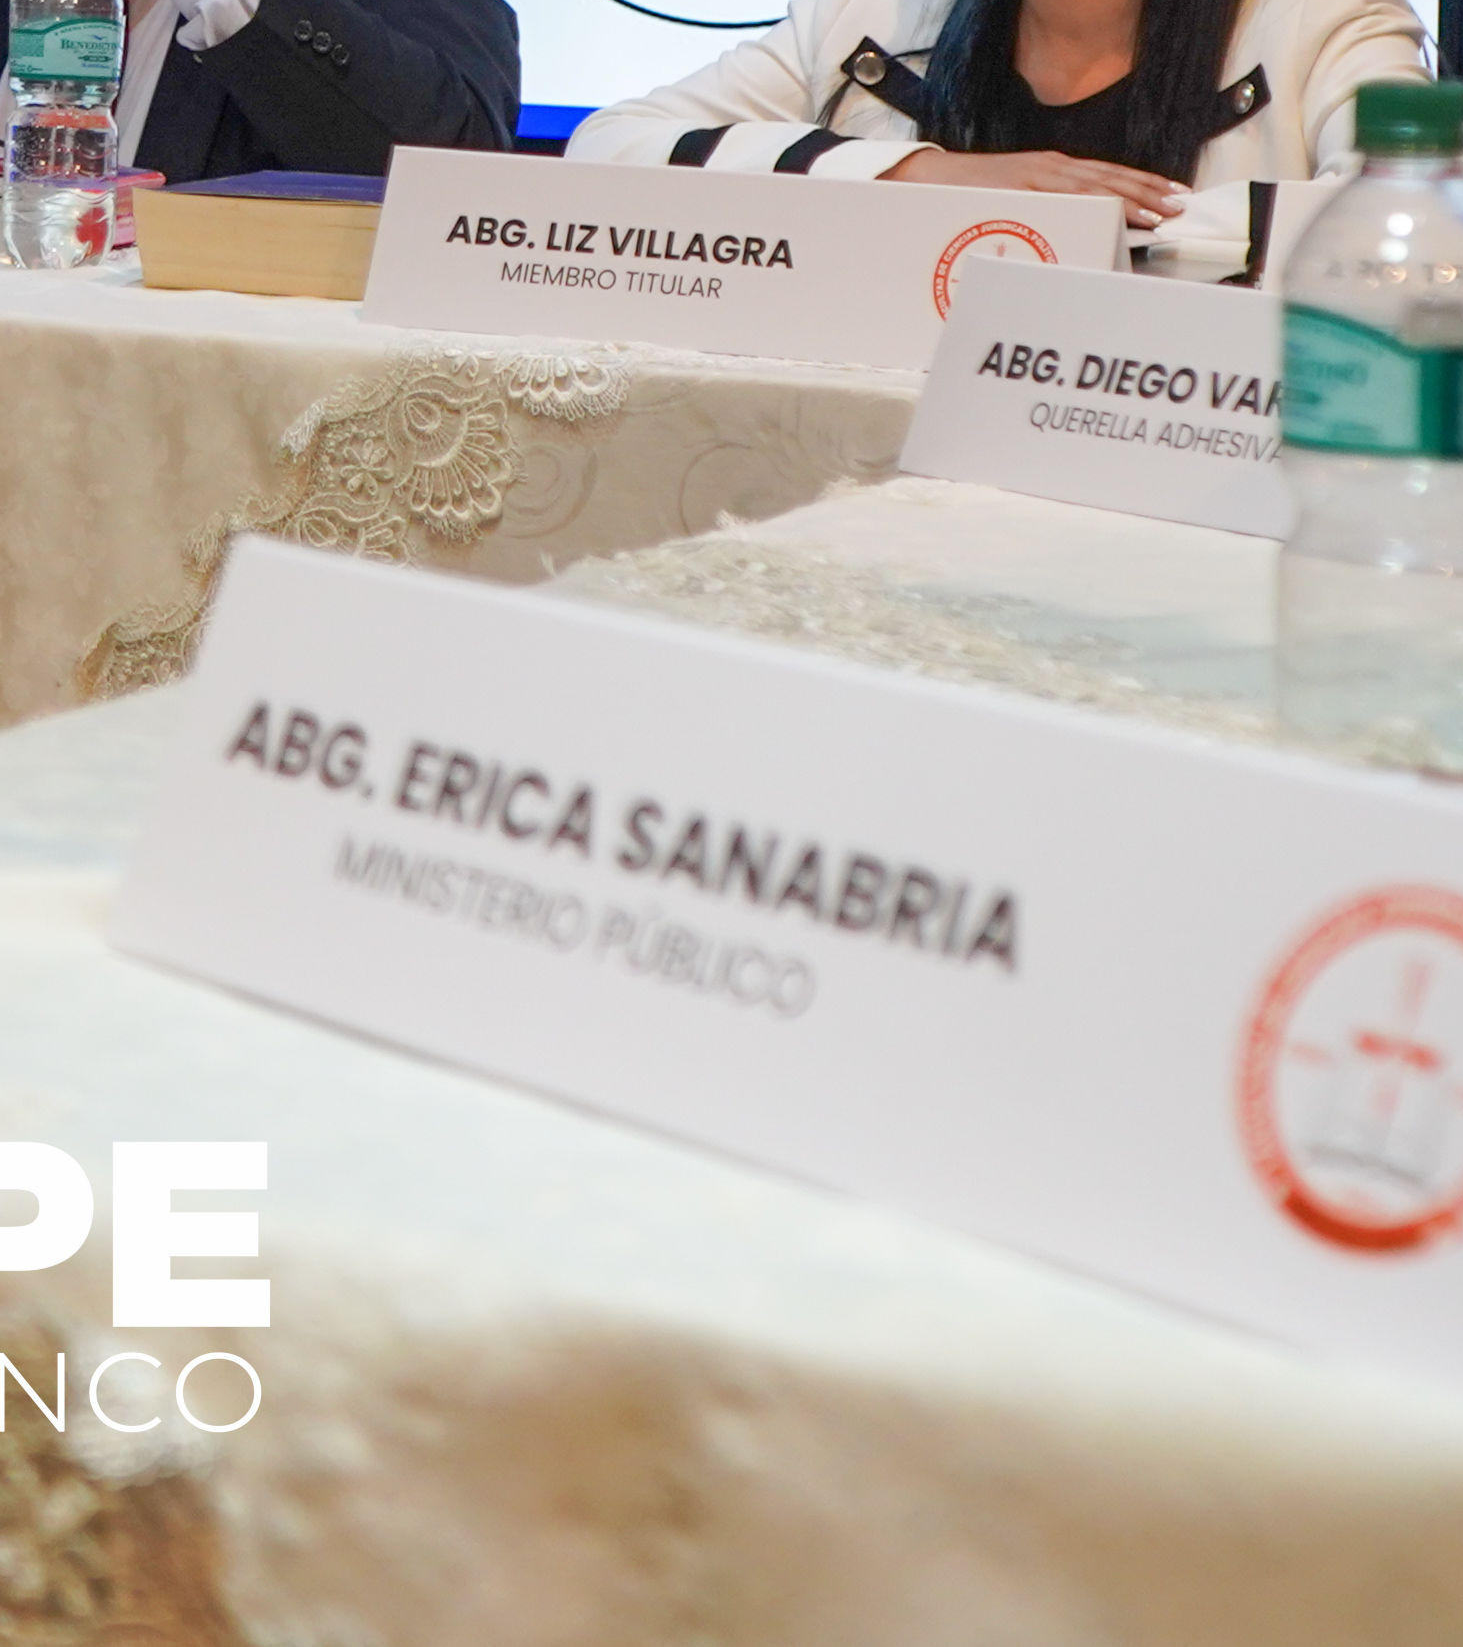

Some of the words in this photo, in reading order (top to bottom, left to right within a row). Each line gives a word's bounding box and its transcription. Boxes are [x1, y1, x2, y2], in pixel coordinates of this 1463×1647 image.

[446, 215, 535, 249] ABG.
[546, 222, 598, 253] LIZ
[609, 226, 794, 269] VILLAGRA
[500, 262, 617, 290] MIEMBRO
[626, 271, 723, 299] TITULAR
[977, 342, 1066, 387] ABG.
[1076, 355, 1198, 404] DIEGO
[1029, 402, 1148, 444] QUERELLA
[226, 700, 374, 804] ABG.
[394, 738, 595, 860] ERICA
[616, 799, 1020, 977] SANABRIA
[333, 833, 588, 954] MINISTERIO
[595, 904, 816, 1020] PÚBLICO
